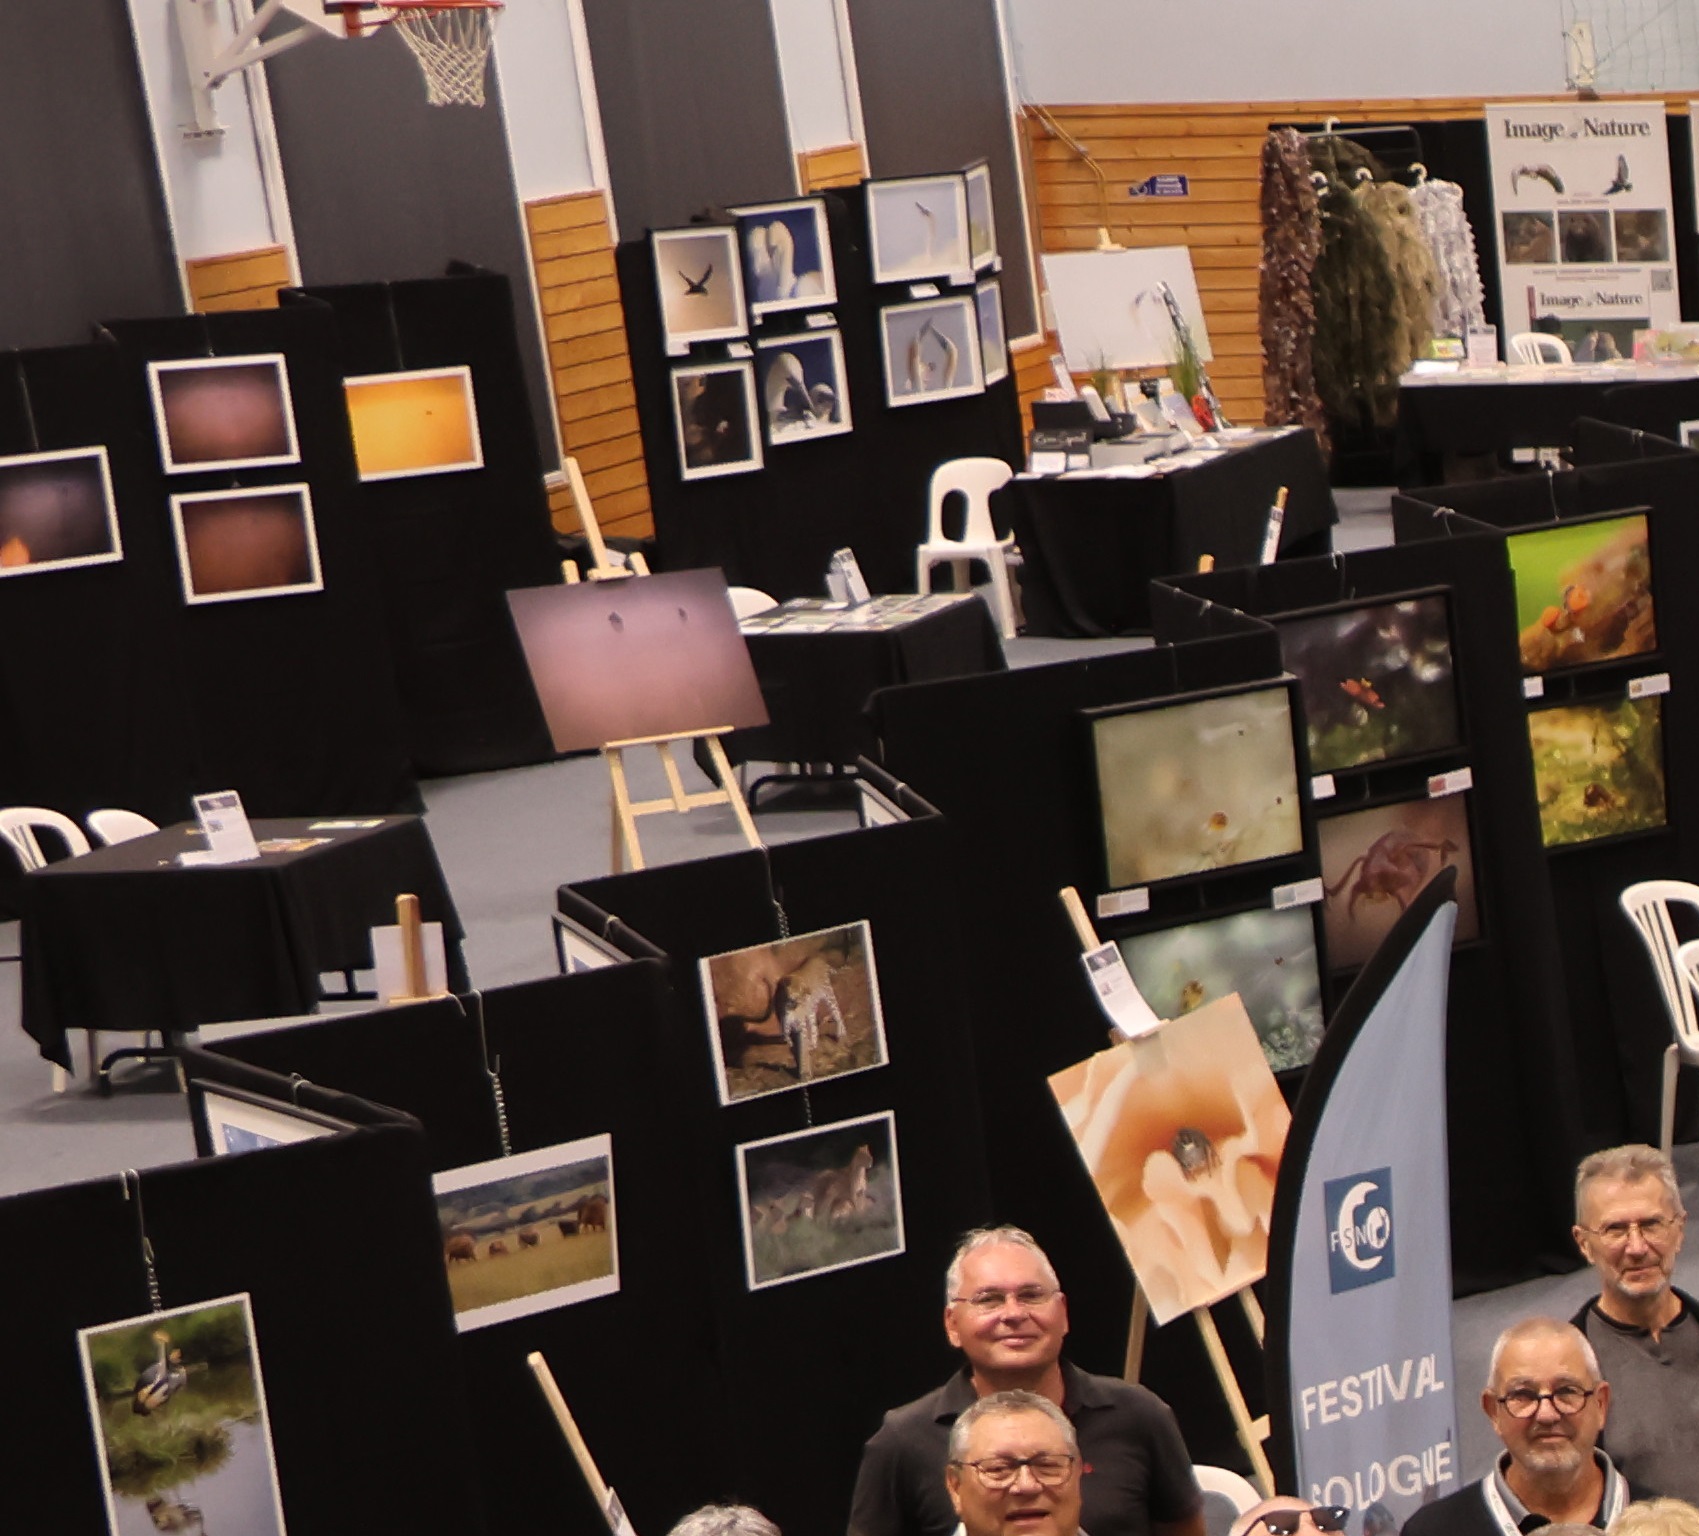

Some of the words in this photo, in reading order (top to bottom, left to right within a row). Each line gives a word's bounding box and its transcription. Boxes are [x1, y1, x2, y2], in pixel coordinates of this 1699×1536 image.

[1504, 118, 1564, 142] Image
[1583, 117, 1651, 138] Nature
[1541, 292, 1584, 308] Image
[1596, 292, 1643, 306] Nature
[1303, 1353, 1444, 1430] FESTIVAL
